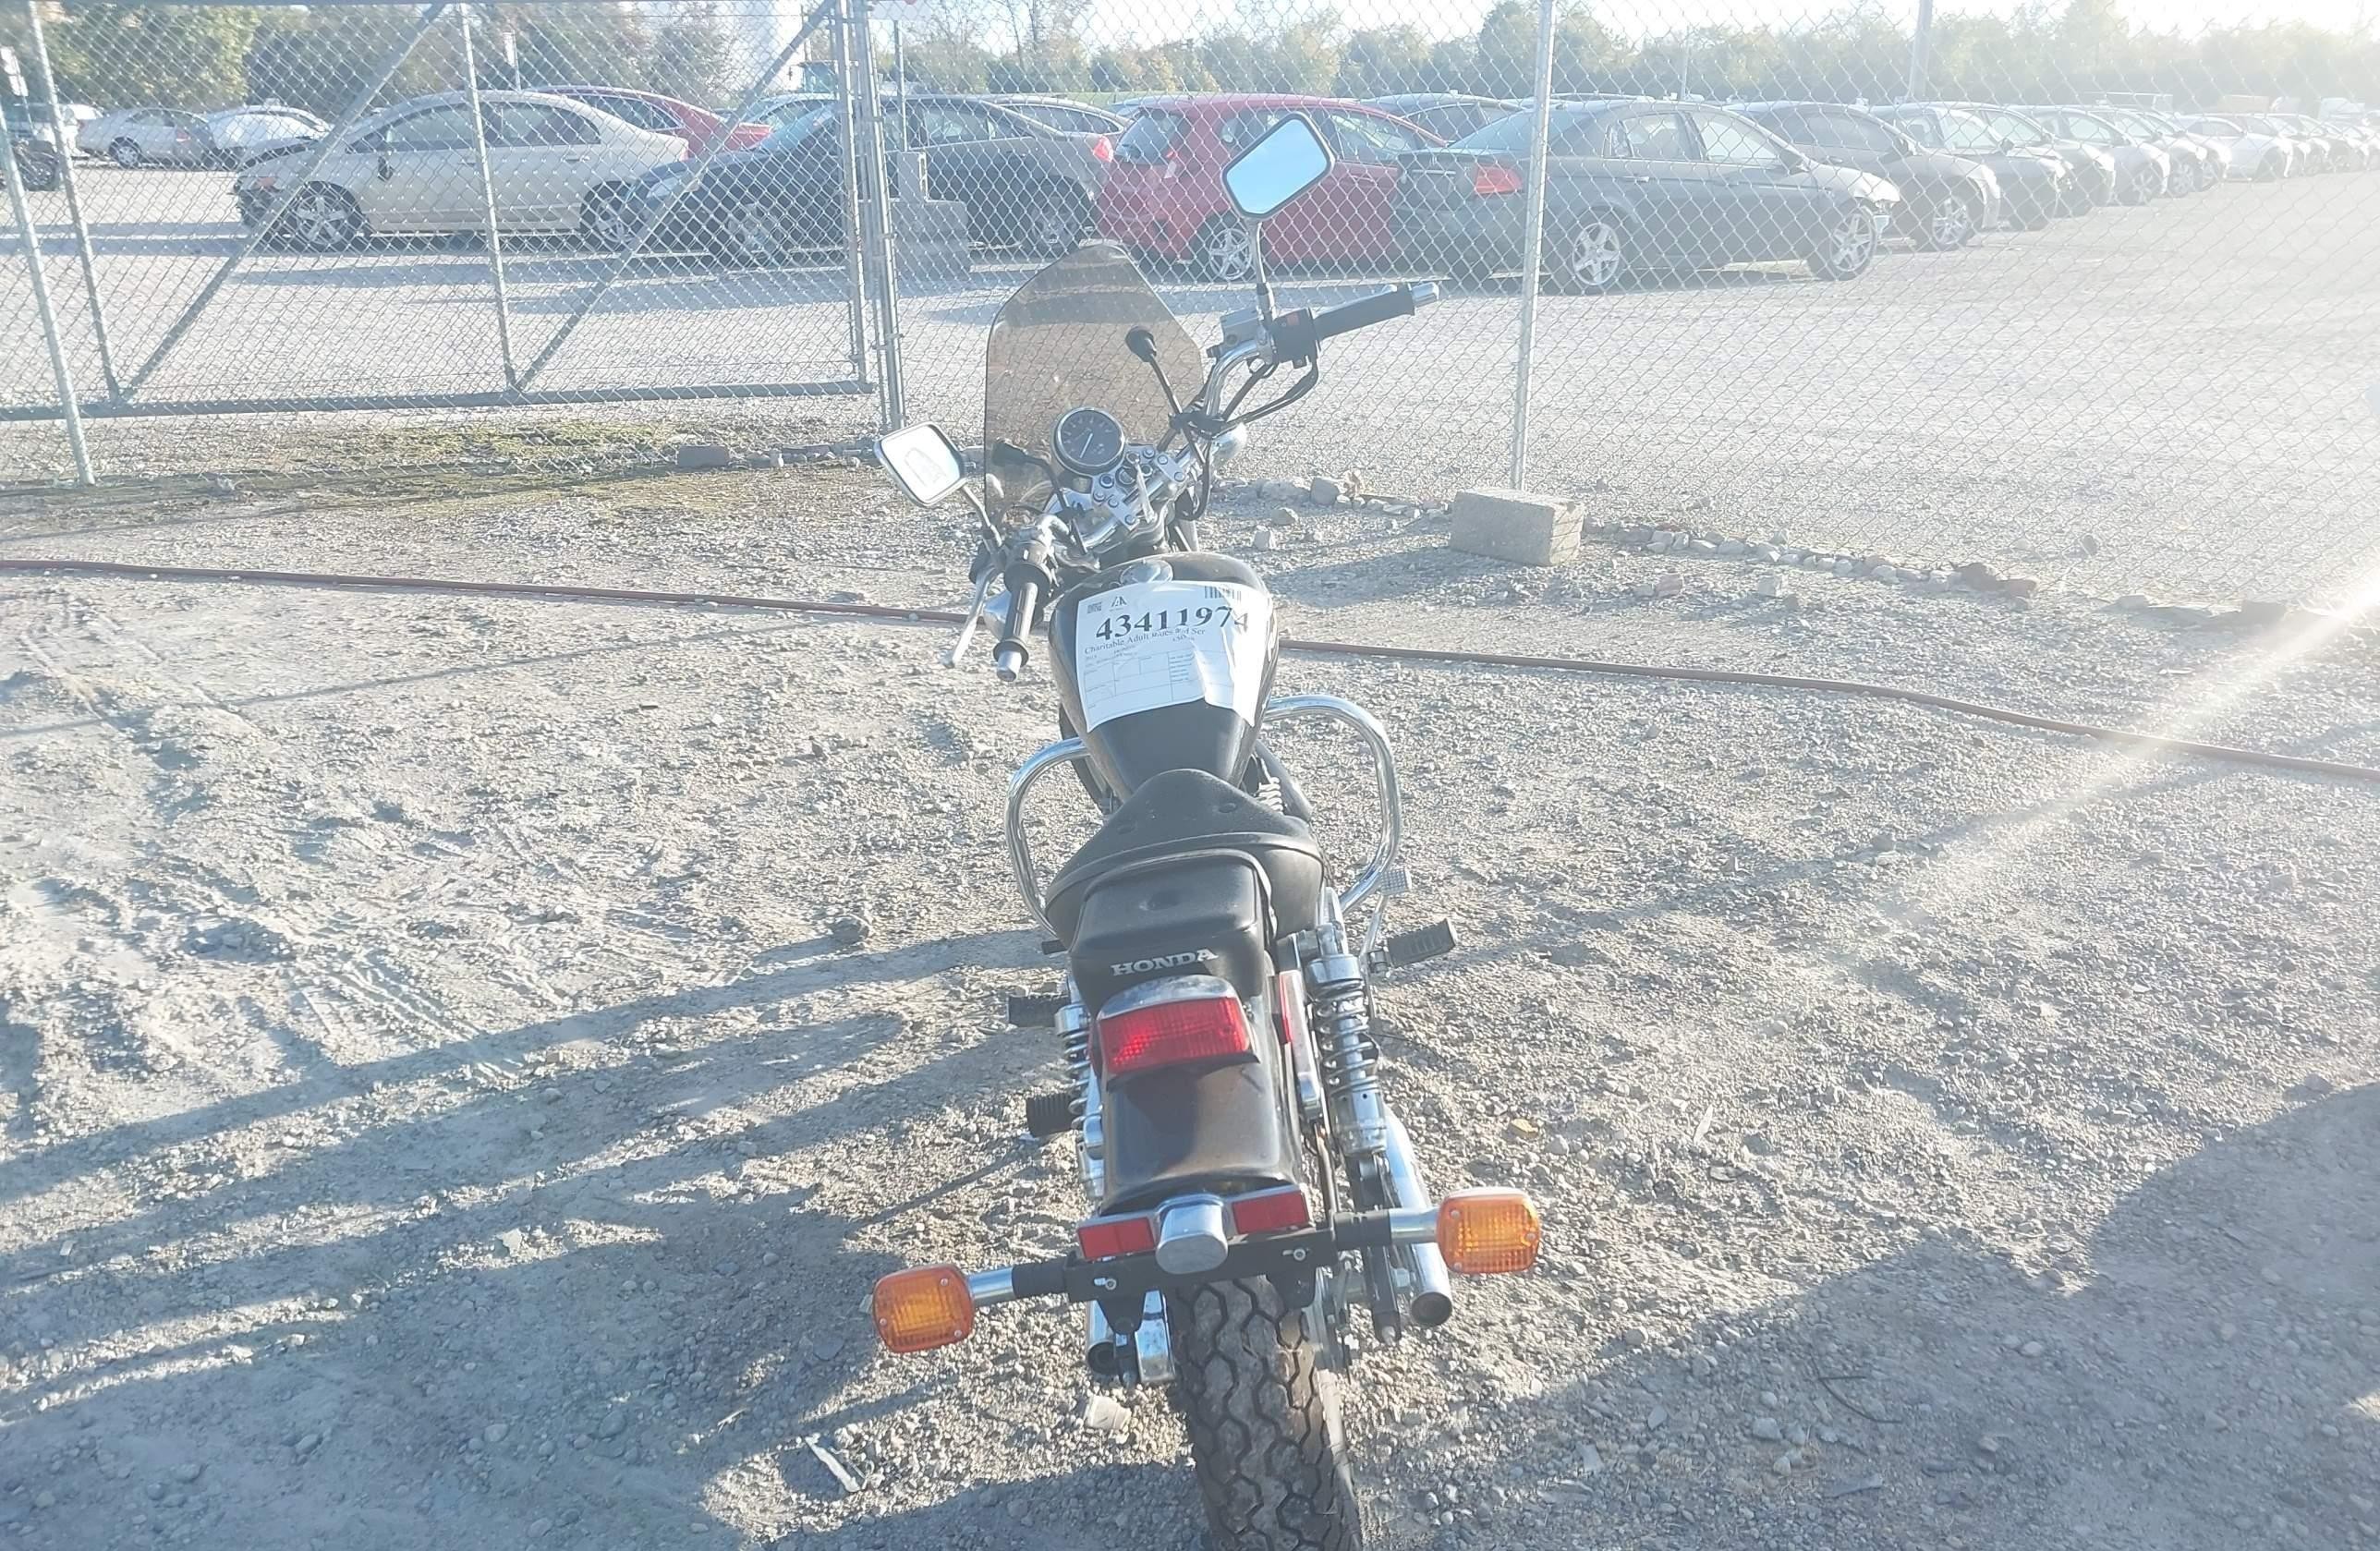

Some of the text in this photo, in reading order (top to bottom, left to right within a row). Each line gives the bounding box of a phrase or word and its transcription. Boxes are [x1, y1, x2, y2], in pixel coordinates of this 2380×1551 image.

[1096, 606, 1249, 640] 43411974
[1084, 639, 1124, 654] Charitable
[1111, 949, 1219, 976] HONDA
